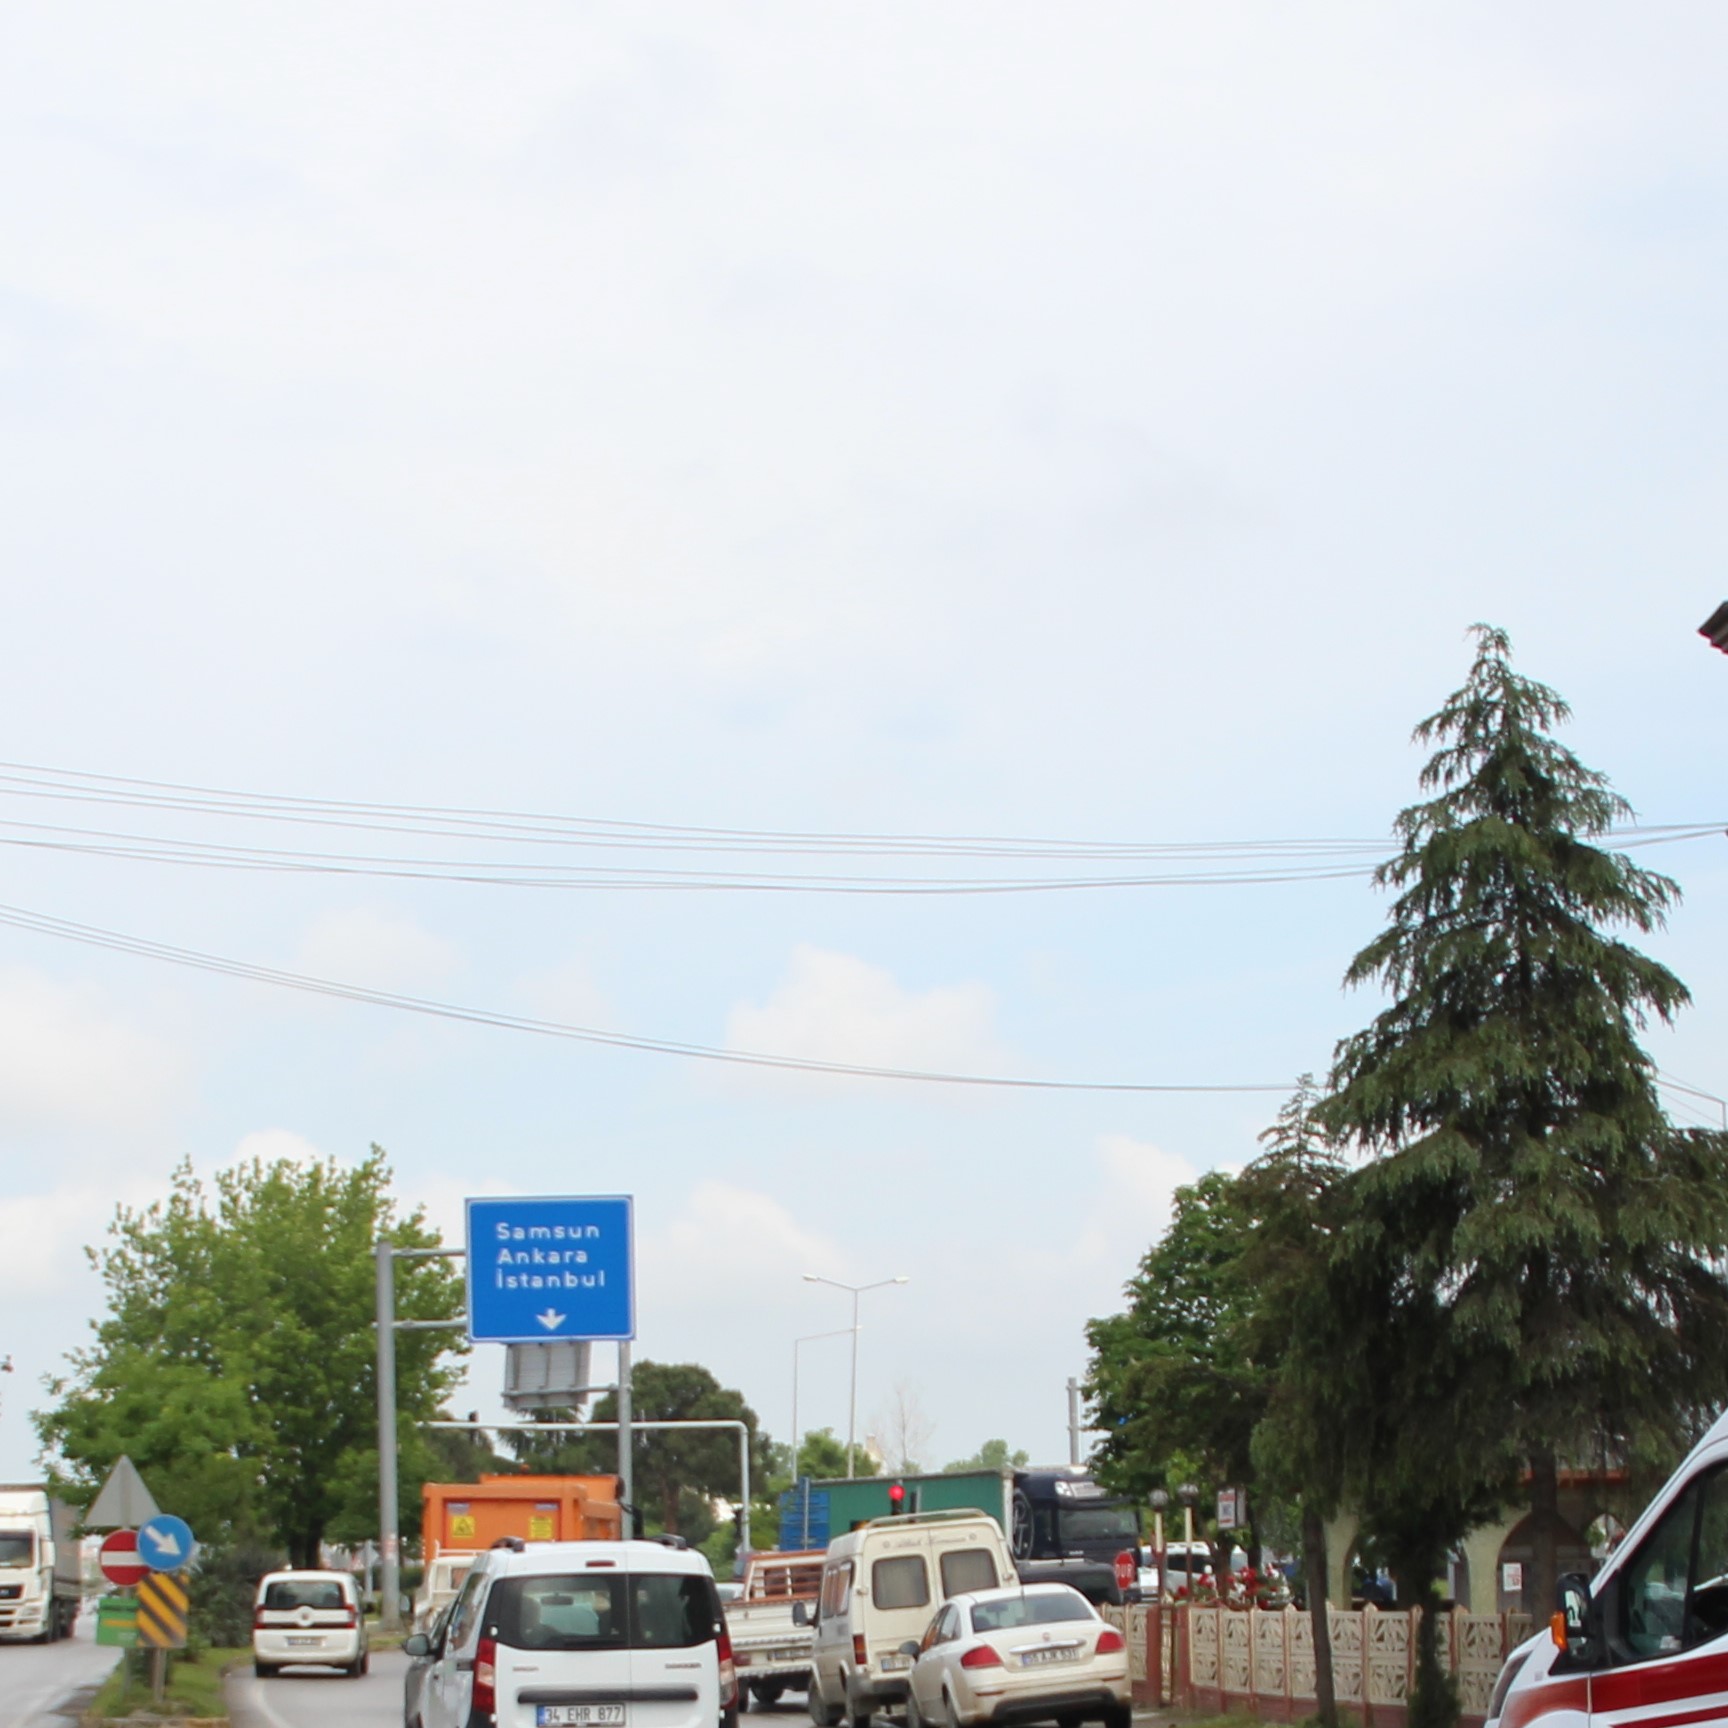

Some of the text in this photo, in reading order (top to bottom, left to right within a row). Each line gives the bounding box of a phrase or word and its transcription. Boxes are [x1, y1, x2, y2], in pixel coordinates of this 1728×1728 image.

[496, 1222, 600, 1240] Samsun
[497, 1248, 588, 1264] Ankara
[496, 1268, 605, 1288] İstanbul
[545, 1706, 622, 1723] 34 EHR 877
